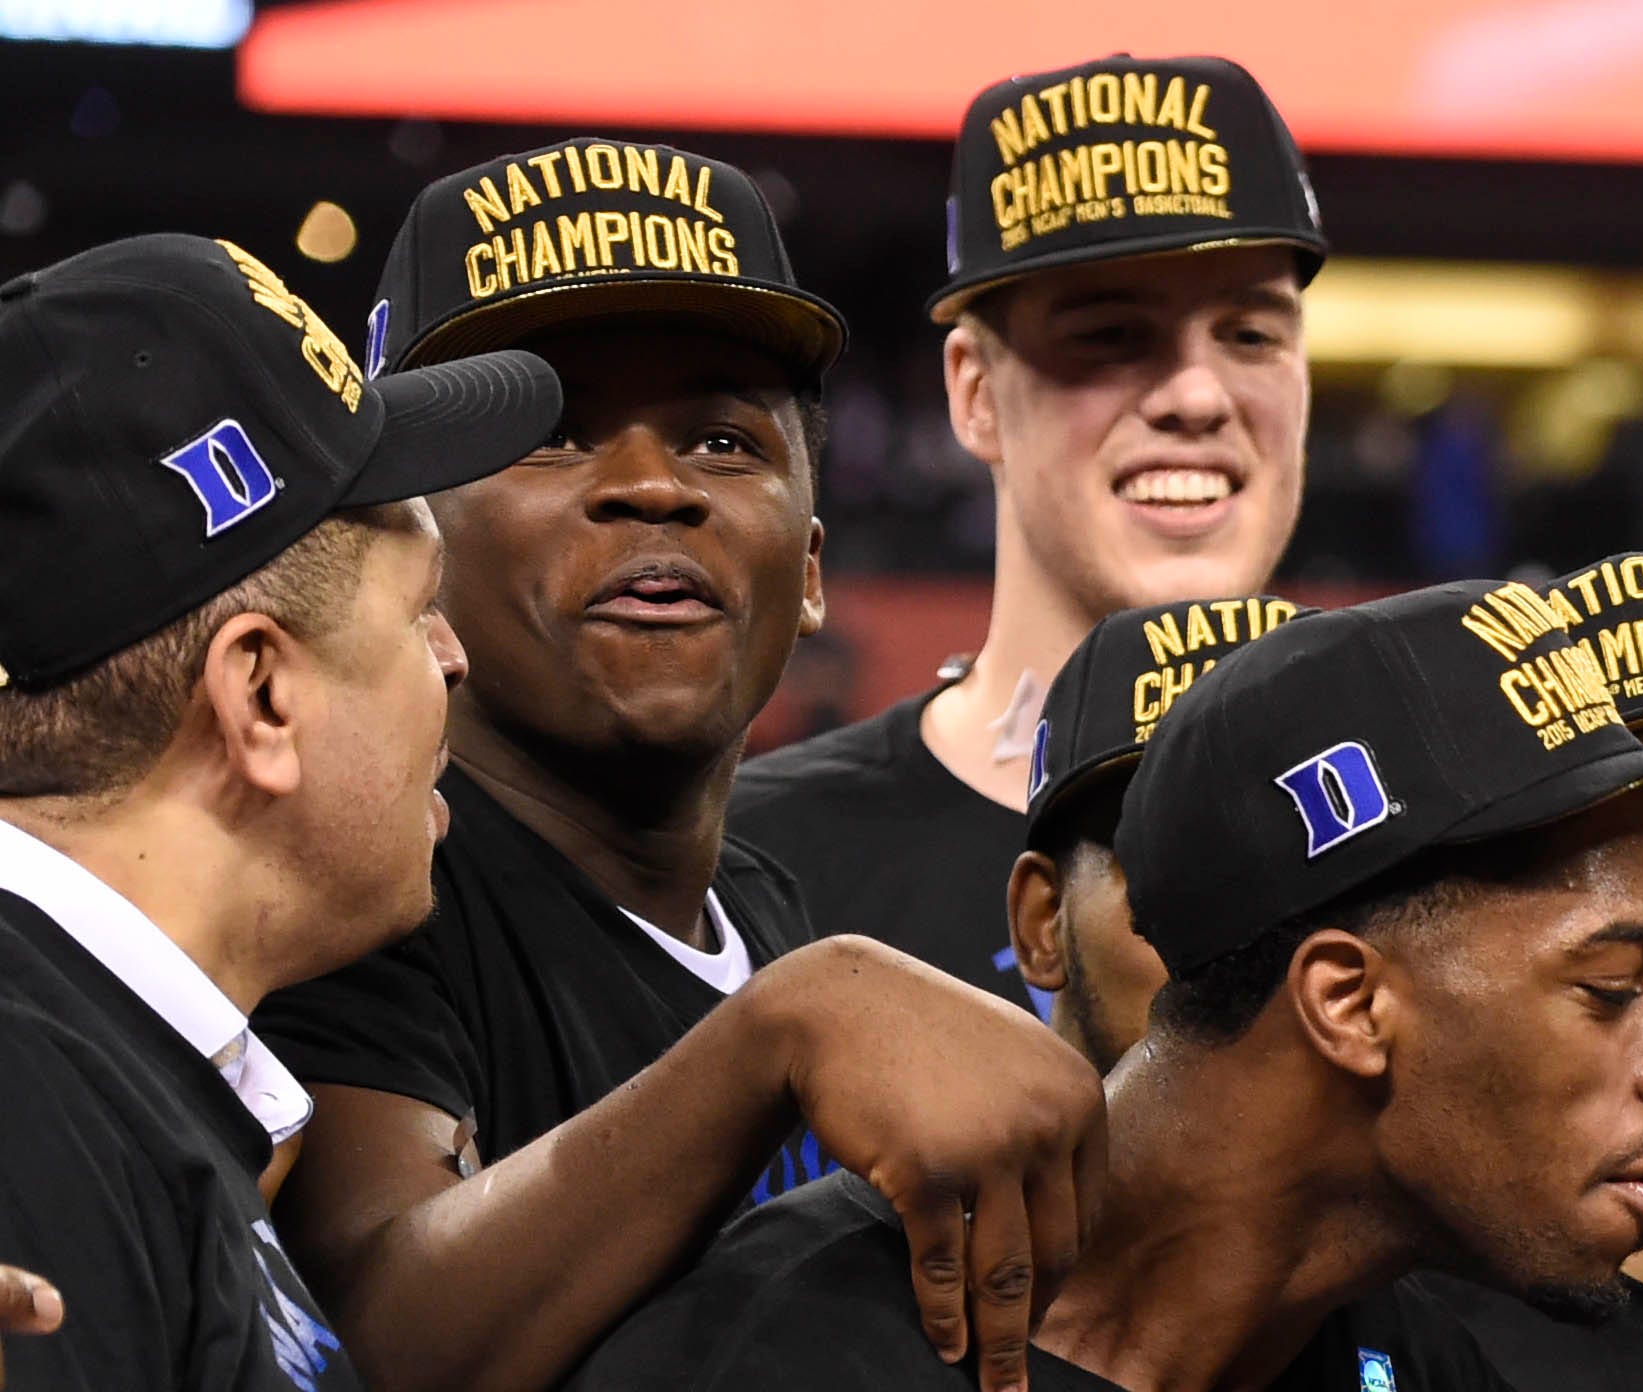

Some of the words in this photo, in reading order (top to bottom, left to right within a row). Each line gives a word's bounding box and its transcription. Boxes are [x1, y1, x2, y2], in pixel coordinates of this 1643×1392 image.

[990, 72, 1217, 166] NATIONAL
[463, 144, 724, 235] NATIONAL
[990, 138, 1231, 229] CHAMPIONS
[465, 211, 740, 300] CHAMPIONS
[1143, 598, 1298, 666] NATIO
[1536, 720, 1576, 751] 2015
